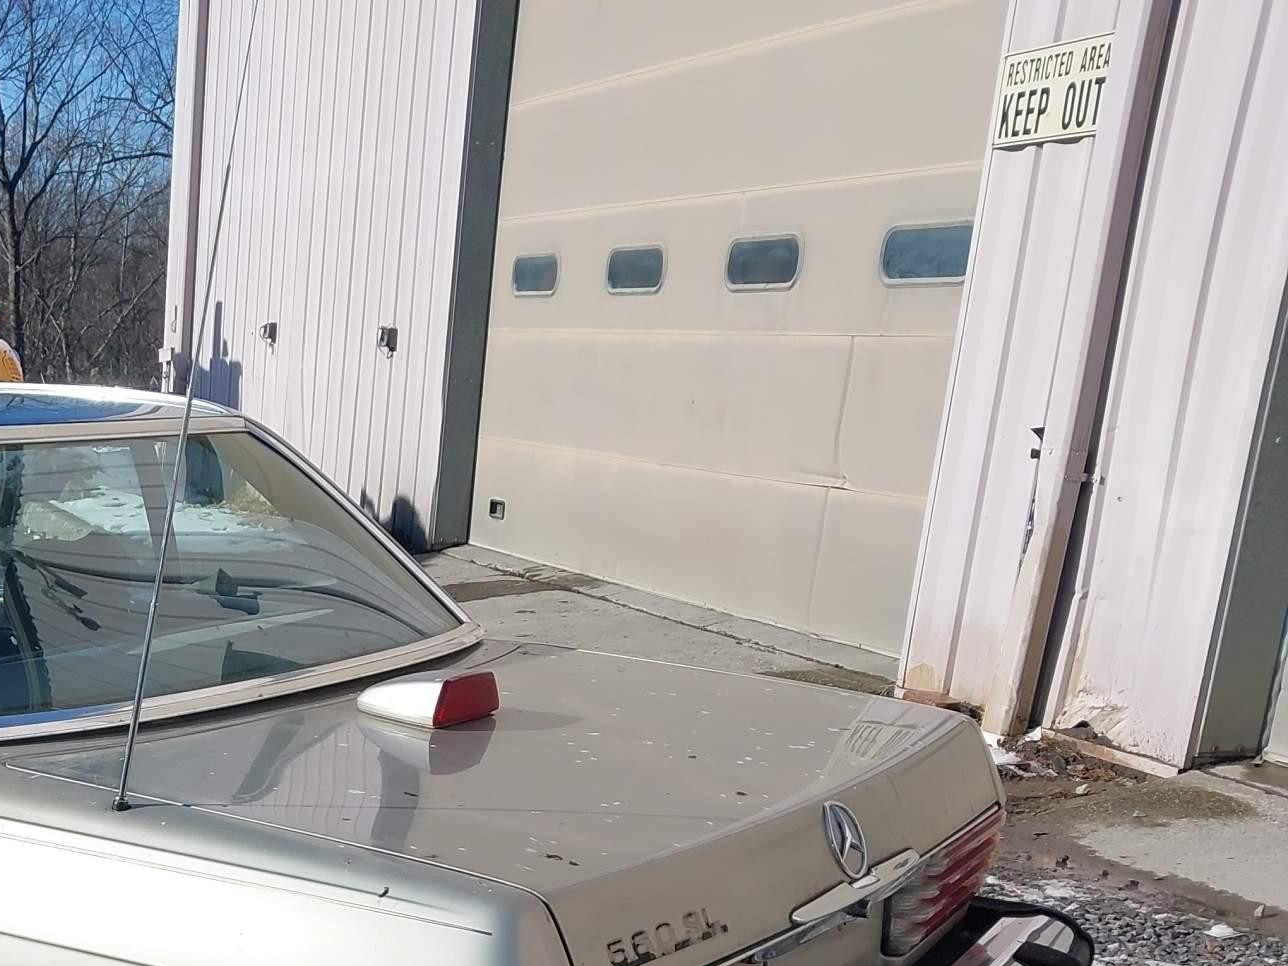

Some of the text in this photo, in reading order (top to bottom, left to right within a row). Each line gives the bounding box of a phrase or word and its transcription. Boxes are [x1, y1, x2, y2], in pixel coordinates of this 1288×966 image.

[1006, 42, 1112, 87] RESTRICTED AREA
[998, 76, 1107, 139] KEEP OUT
